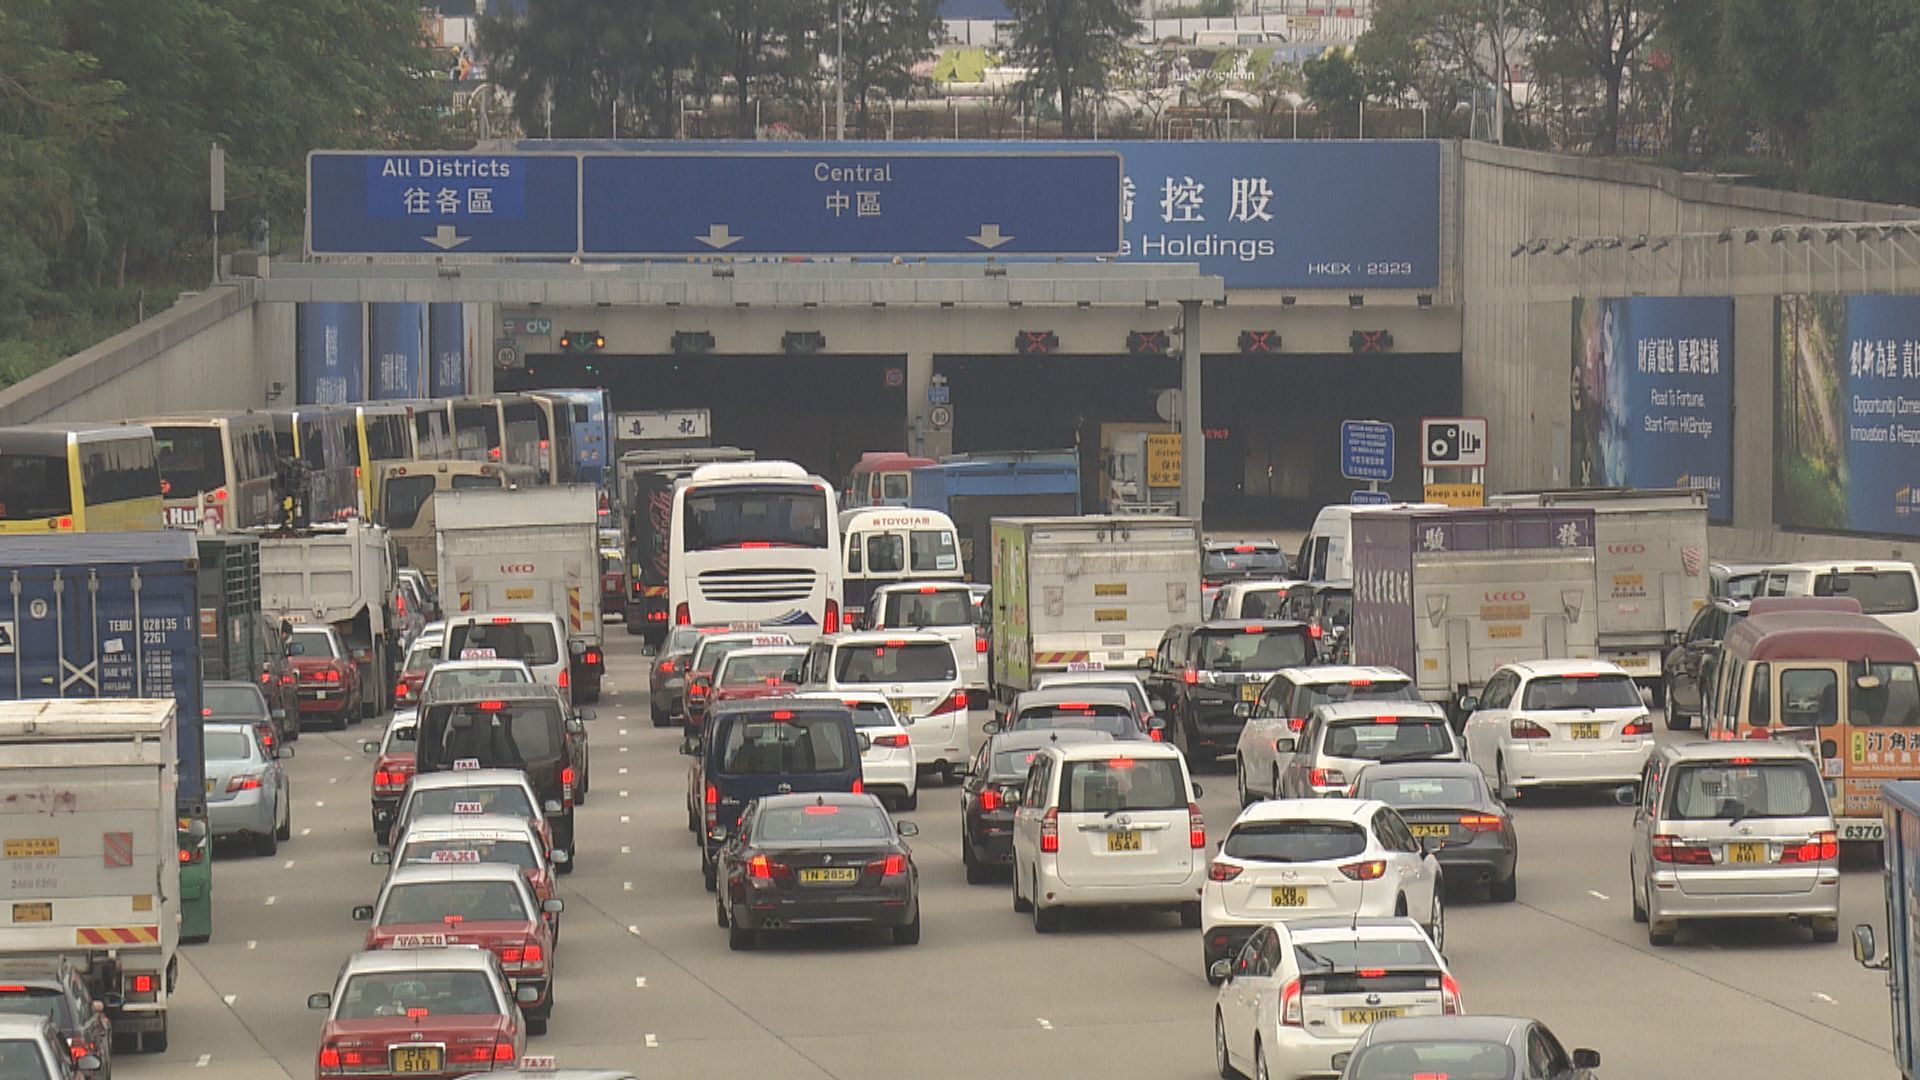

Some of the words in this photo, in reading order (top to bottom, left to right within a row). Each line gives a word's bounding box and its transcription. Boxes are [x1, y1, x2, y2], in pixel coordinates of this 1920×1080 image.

[382, 158, 412, 178] All
[419, 158, 510, 178] Districts
[814, 162, 892, 182] Central
[404, 187, 493, 214] 往各區
[825, 190, 881, 217] 中區
[1142, 234, 1275, 261] Holdings
[1308, 262, 1351, 275] HKEX
[1367, 262, 1412, 275] 2323
[1426, 489, 1450, 499] Keep
[1460, 488, 1481, 497] safe
[755, 636, 785, 644] TAXI
[455, 761, 478, 769] TAXI
[457, 803, 480, 812] TAXI
[1845, 826, 1882, 838] 6370
[436, 851, 476, 862] TAXI
[399, 936, 442, 946] TAXI
[1349, 1012, 1367, 1024] KX
[522, 1058, 553, 1069] TAXI
